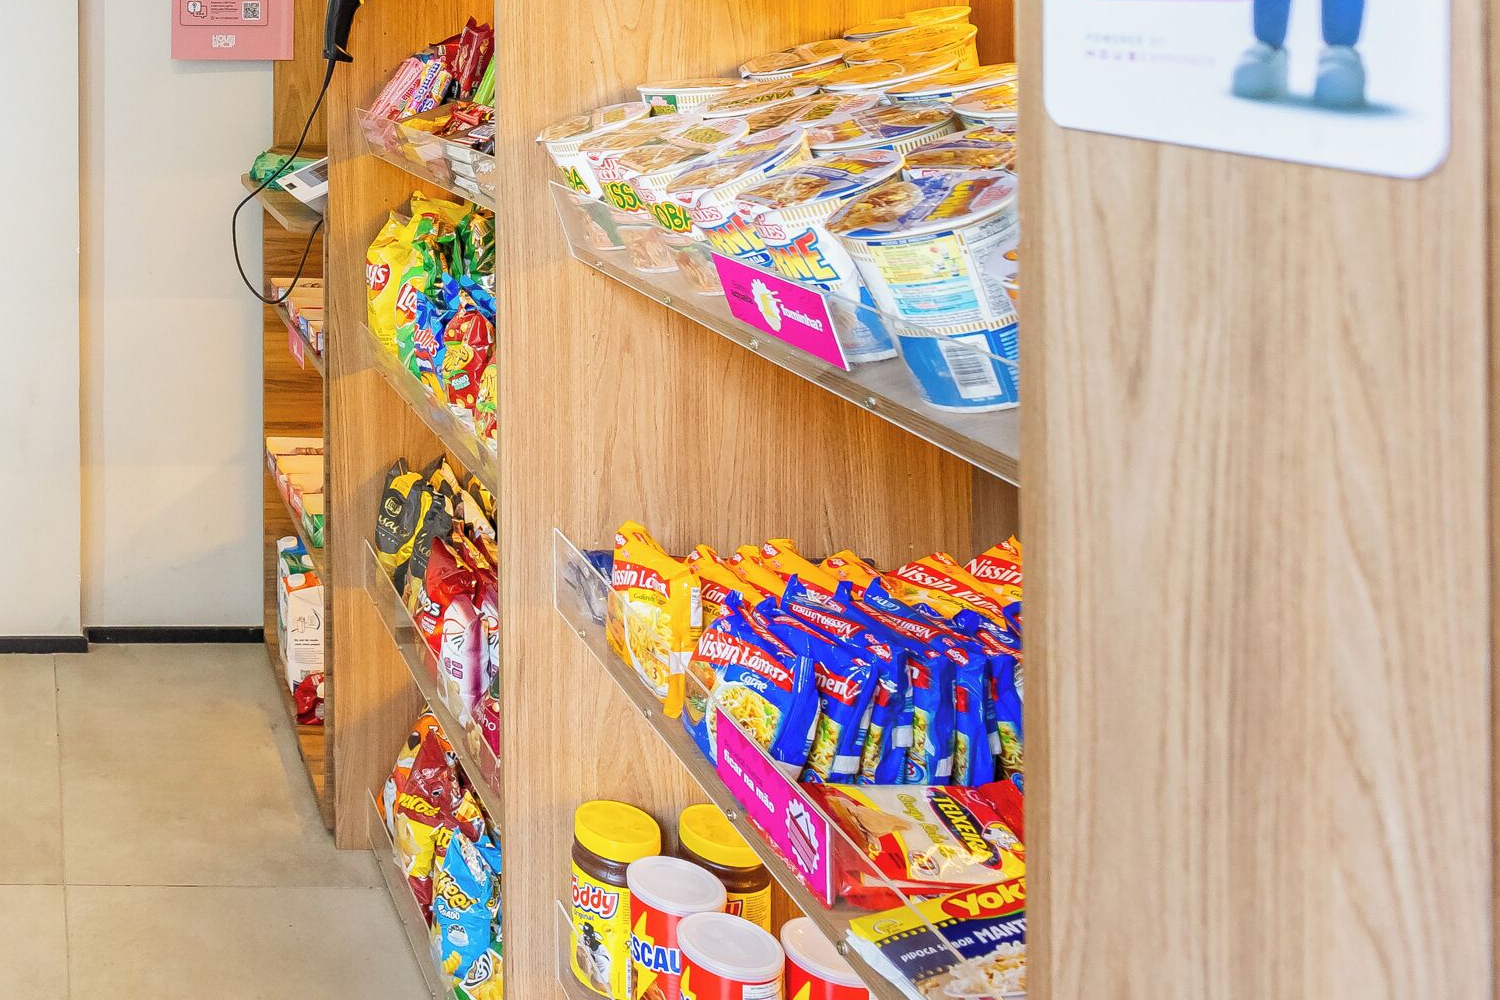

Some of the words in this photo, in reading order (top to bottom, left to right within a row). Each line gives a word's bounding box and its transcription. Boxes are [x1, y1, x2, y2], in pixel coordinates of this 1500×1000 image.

[897, 564, 959, 592] Nissin
[739, 670, 770, 694] Carne
[723, 748, 743, 777] ficar
[743, 772, 755, 792] na
[755, 785, 775, 814] mão
[900, 946, 938, 963] PIPOCA
